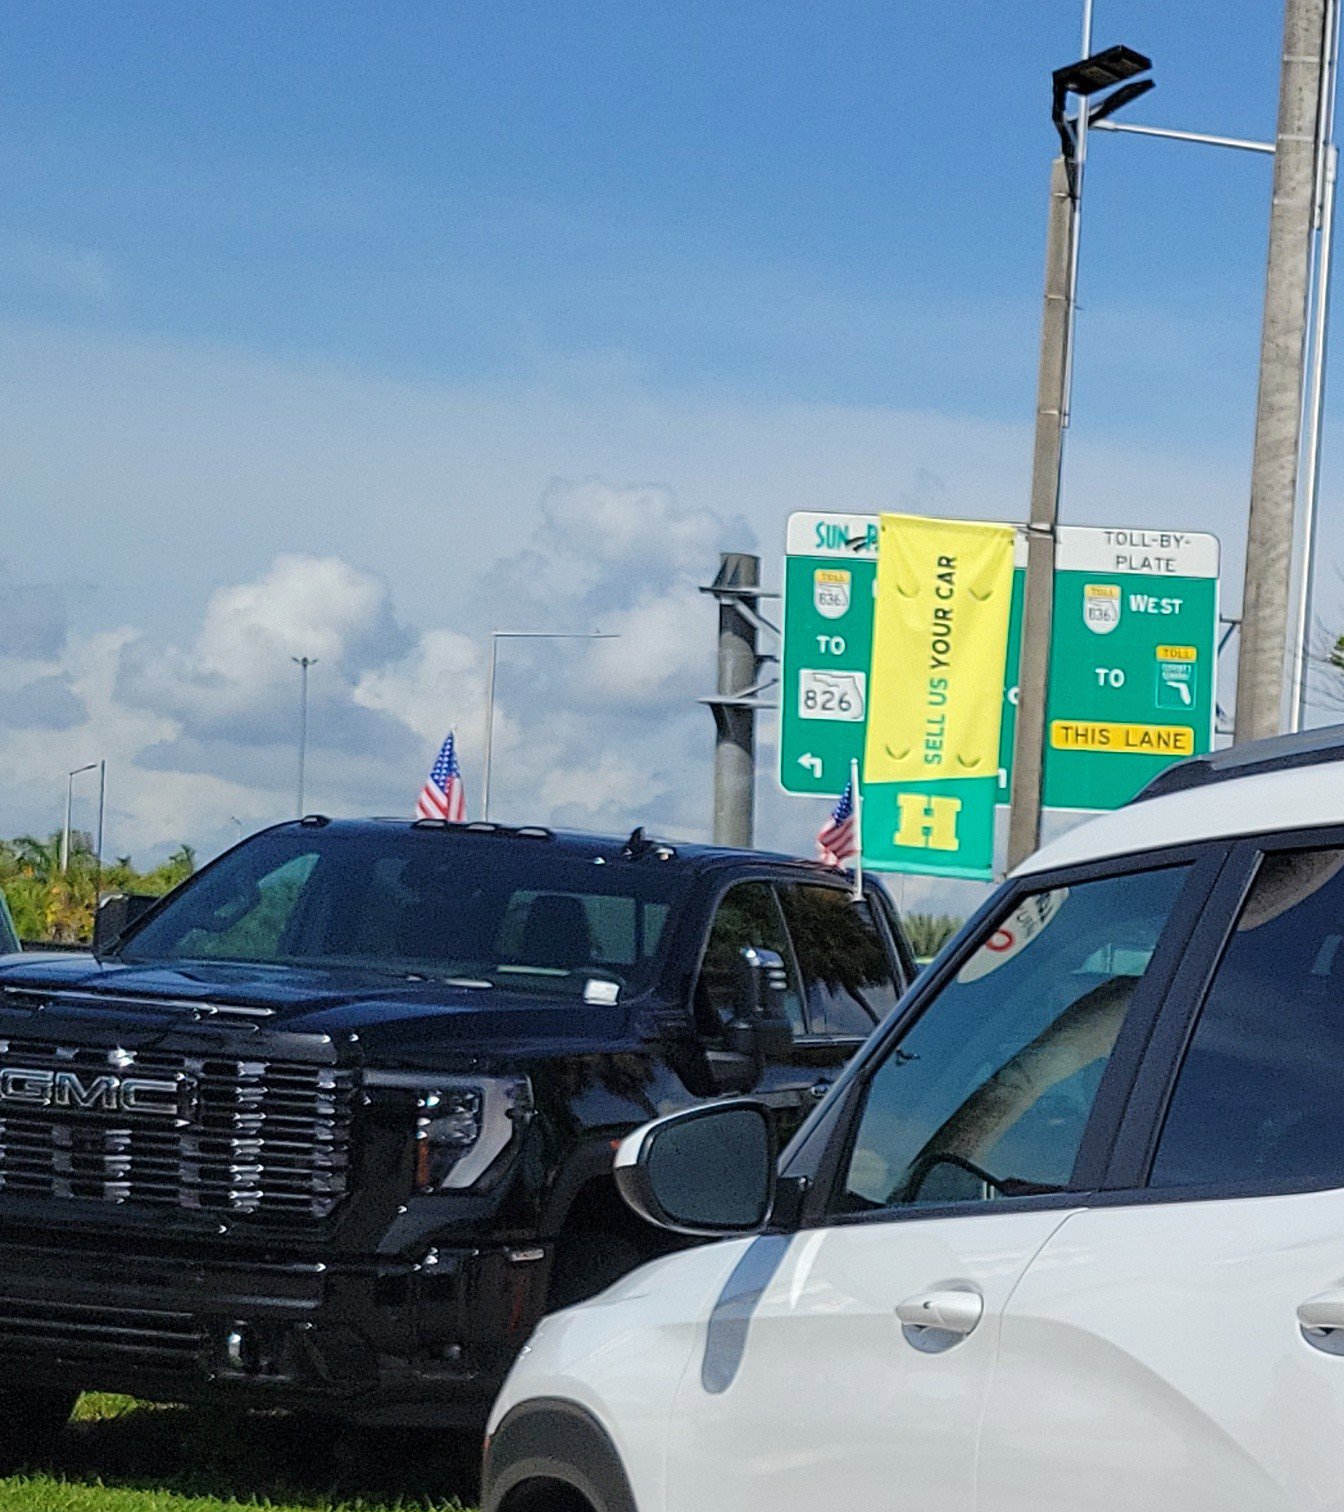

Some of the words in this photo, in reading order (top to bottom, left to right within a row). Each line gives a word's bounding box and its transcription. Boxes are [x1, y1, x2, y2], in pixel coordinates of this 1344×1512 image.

[1115, 555, 1177, 573] PLATE
[935, 554, 958, 601] CAR
[1128, 594, 1184, 615] WEST
[816, 635, 846, 656] TO
[931, 606, 955, 670] YOUR
[1163, 648, 1192, 660] TOLL
[1095, 667, 1125, 688] TO
[804, 689, 852, 712] 826
[928, 676, 949, 706] US
[924, 713, 946, 765] SELL
[1060, 725, 1111, 746] THIS
[1125, 729, 1187, 750] LANE
[0, 1067, 178, 1115] GMC
